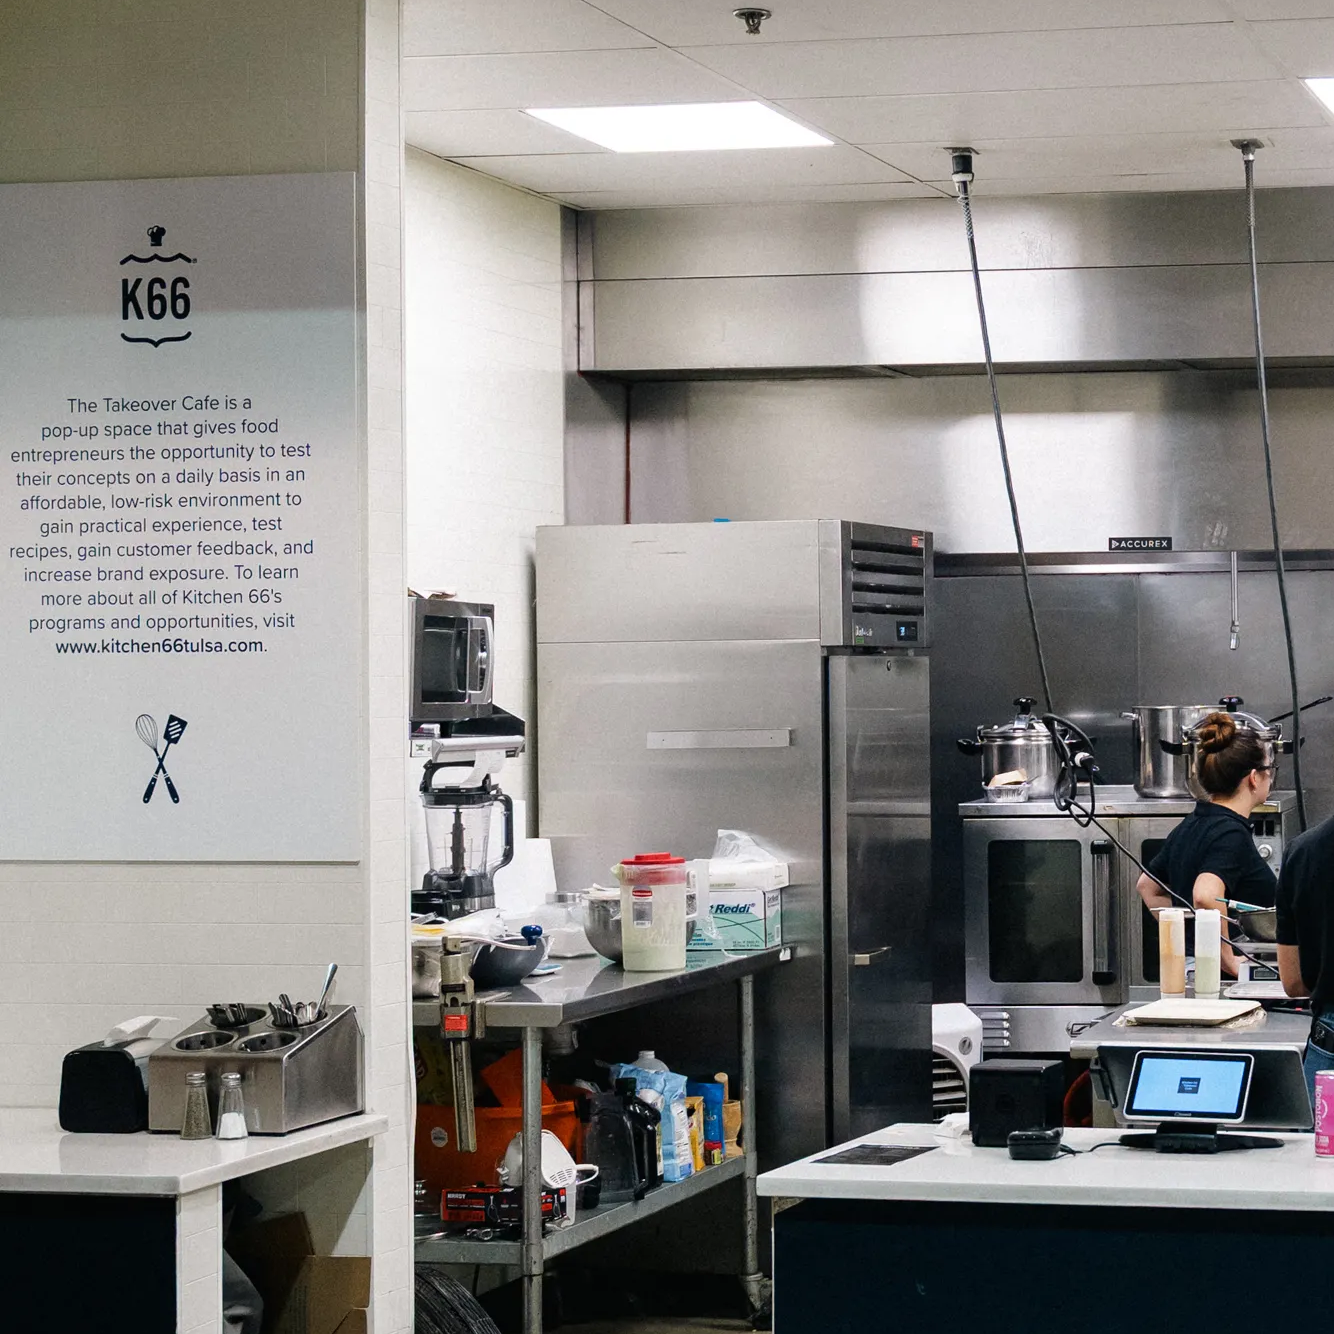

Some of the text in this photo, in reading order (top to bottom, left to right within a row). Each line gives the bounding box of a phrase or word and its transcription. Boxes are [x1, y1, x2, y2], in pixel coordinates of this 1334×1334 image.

[121, 276, 191, 320] K66
[67, 395, 252, 412] The Takeover Cafe is a
[41, 419, 278, 441] pop-up space that gives food
[9, 443, 311, 465] entrepreneurs the opportunity to test
[15, 467, 305, 489] their concepts on a daily basis in an
[19, 491, 302, 511] affordable, low-risk environment to
[39, 515, 283, 537] gain practical experience, test
[9, 540, 314, 562] recipes, gain customer feedback, and
[1120, 540, 1168, 548] ACCUREX
[23, 565, 299, 584] increase brand exposure. To learn
[40, 589, 283, 606] more about all of Kitchen 66's
[28, 613, 295, 633] programs and opportunities, visit
[55, 638, 267, 653] www.kitchen66tulsa.com.
